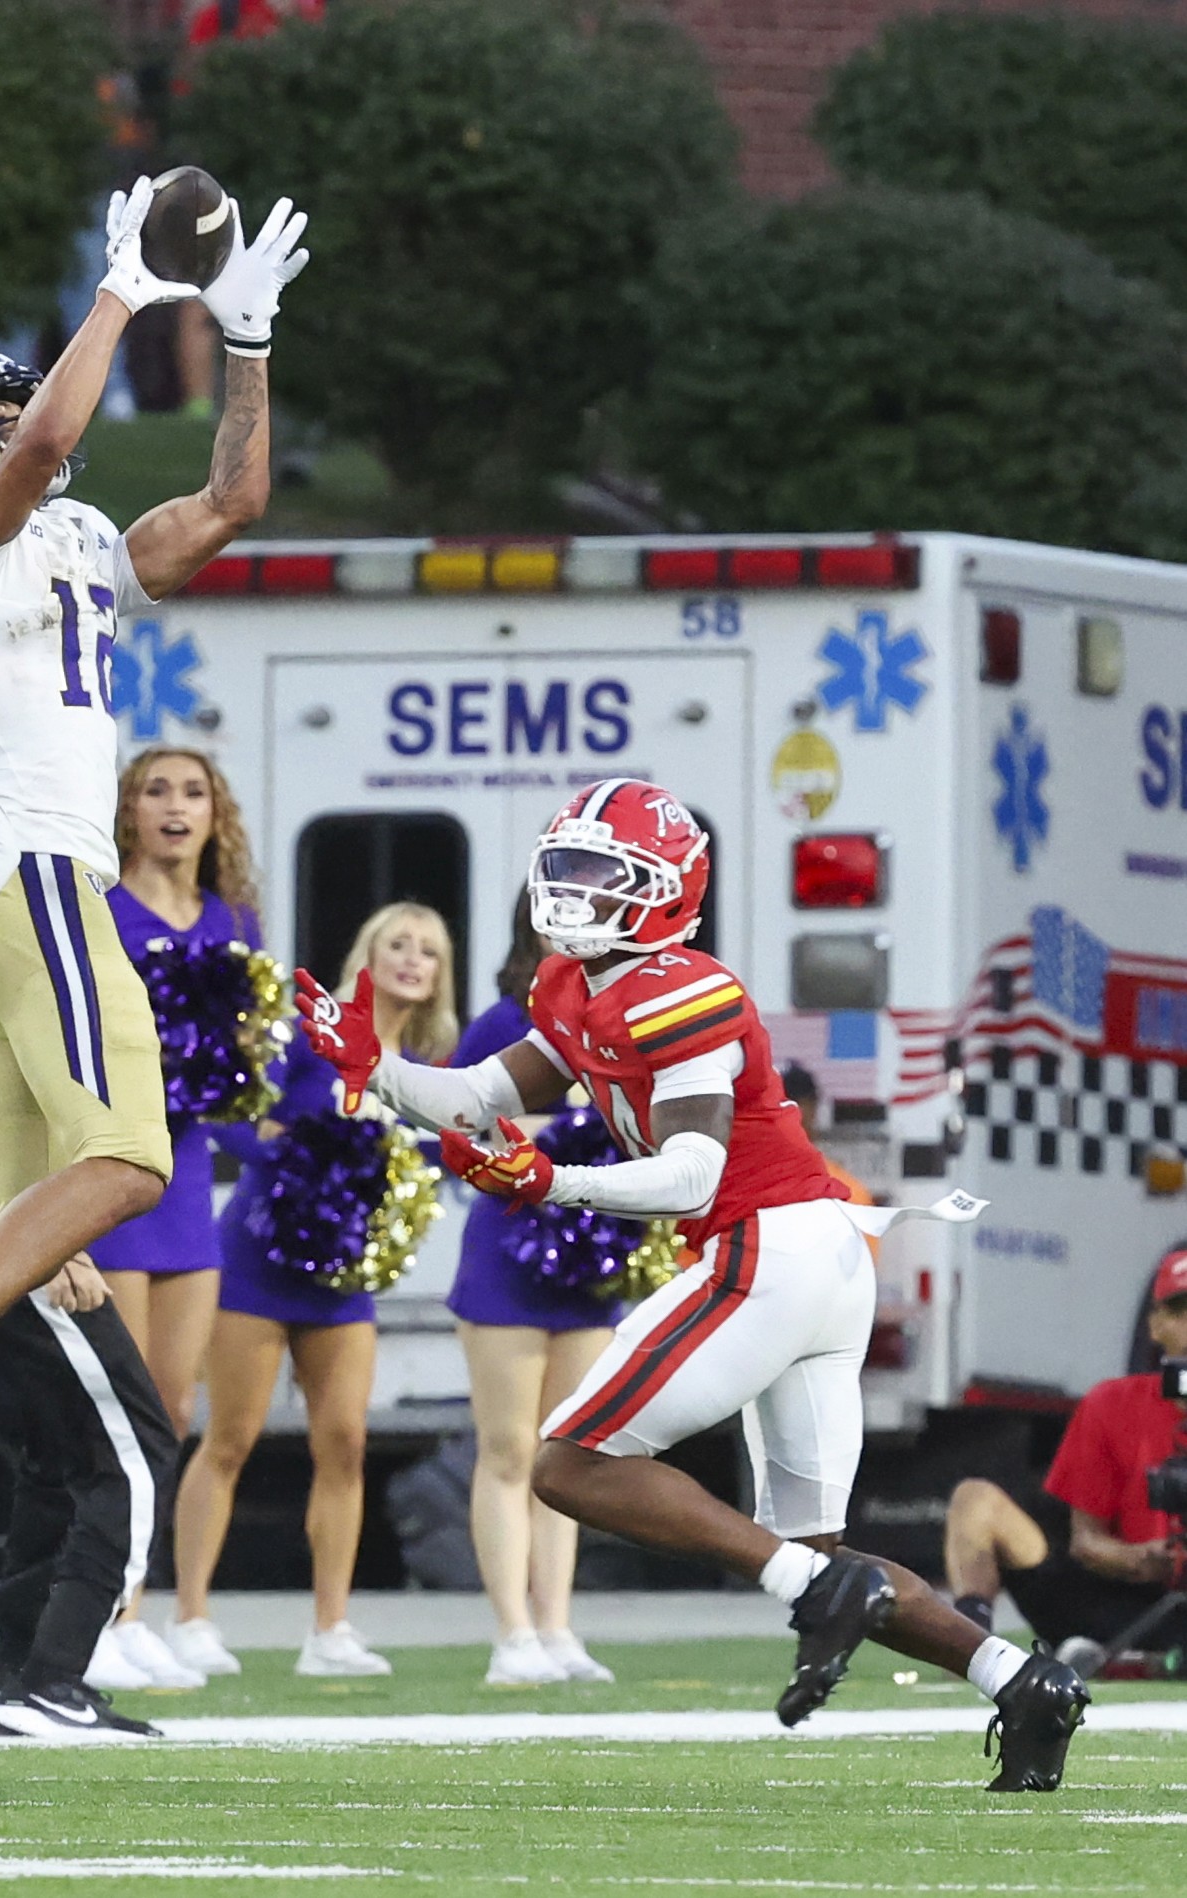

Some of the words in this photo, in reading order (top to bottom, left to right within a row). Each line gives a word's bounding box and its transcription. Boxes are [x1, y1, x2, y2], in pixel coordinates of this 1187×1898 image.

[241, 312, 253, 323] W
[387, 680, 632, 757] SEMS
[639, 953, 692, 977] 14
